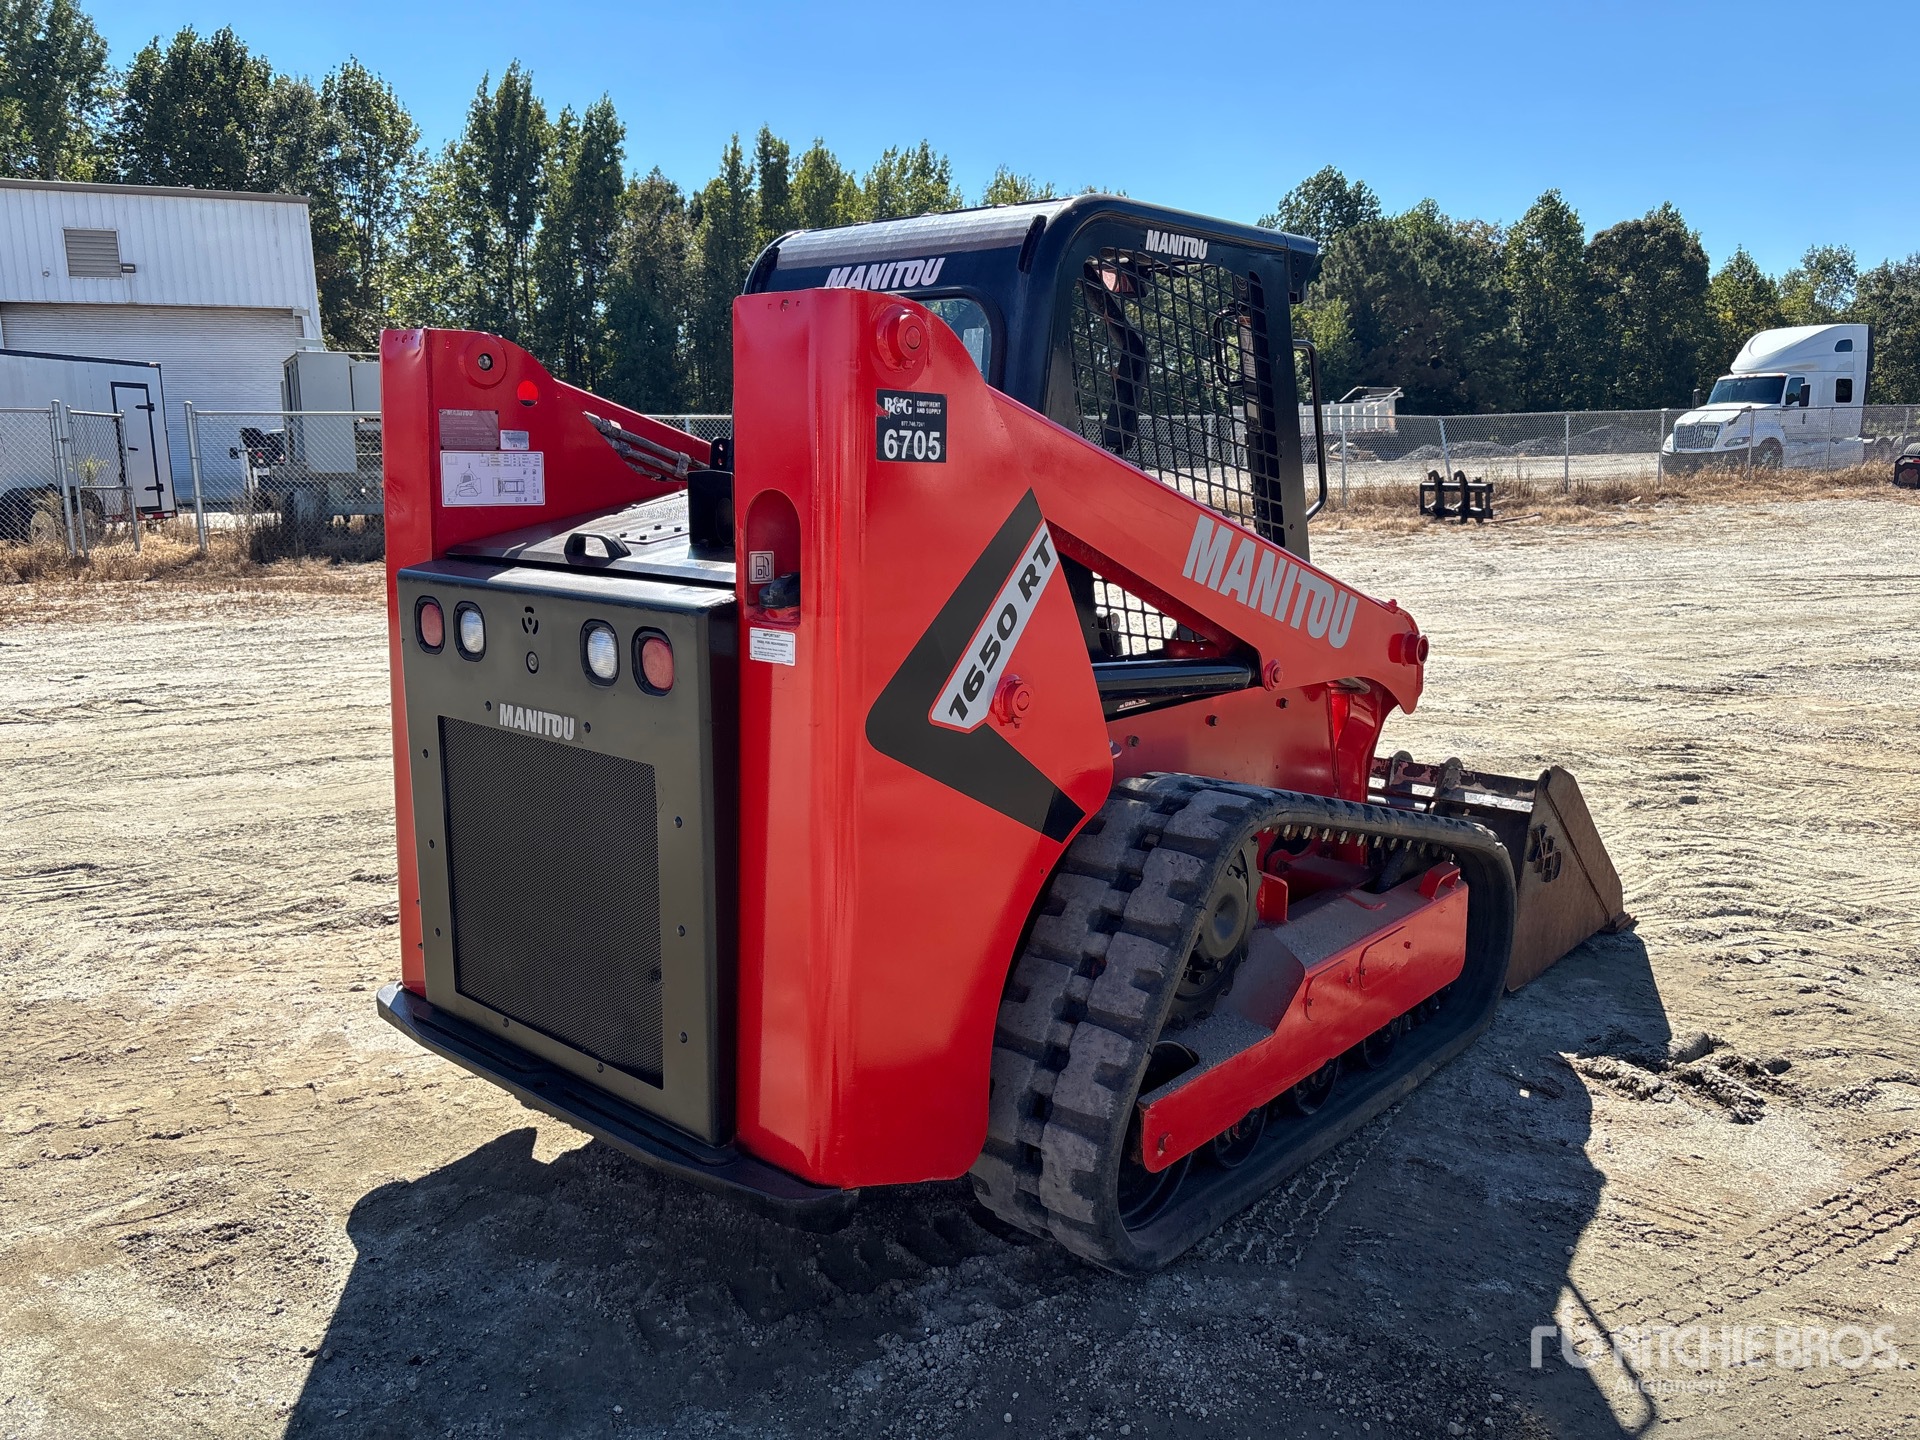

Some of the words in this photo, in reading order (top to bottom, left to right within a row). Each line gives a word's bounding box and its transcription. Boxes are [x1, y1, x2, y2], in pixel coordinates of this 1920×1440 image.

[1145, 229, 1208, 260] MANITOU
[824, 257, 946, 290] MANITOU
[884, 429, 940, 460] 6705
[1182, 514, 1358, 649] MANITOU
[948, 602, 1018, 722] 1650
[1018, 532, 1052, 604] RT
[499, 702, 575, 741] MANITOU
